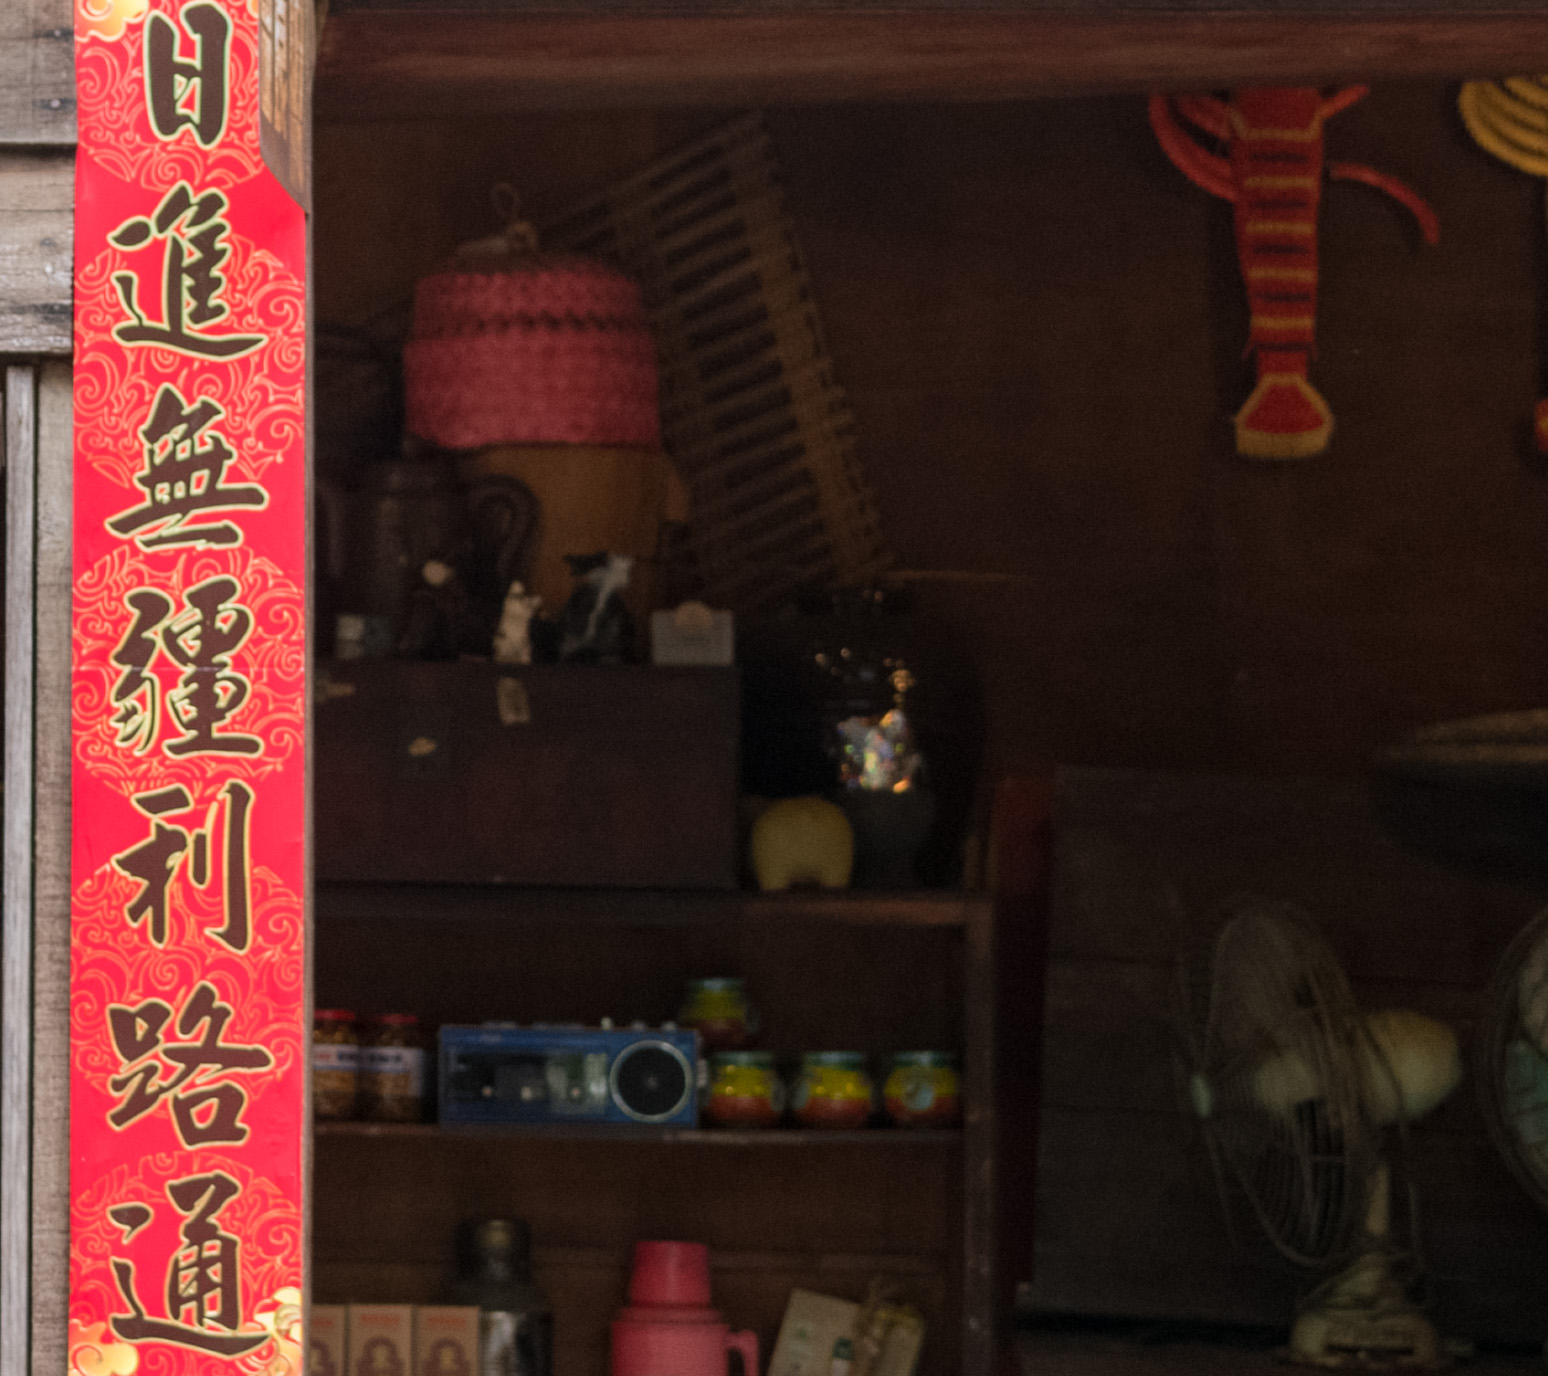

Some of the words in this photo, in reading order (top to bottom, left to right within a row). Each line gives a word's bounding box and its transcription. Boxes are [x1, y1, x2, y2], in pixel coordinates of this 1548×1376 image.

[106, 3, 273, 1355] 日進無疆利路通
